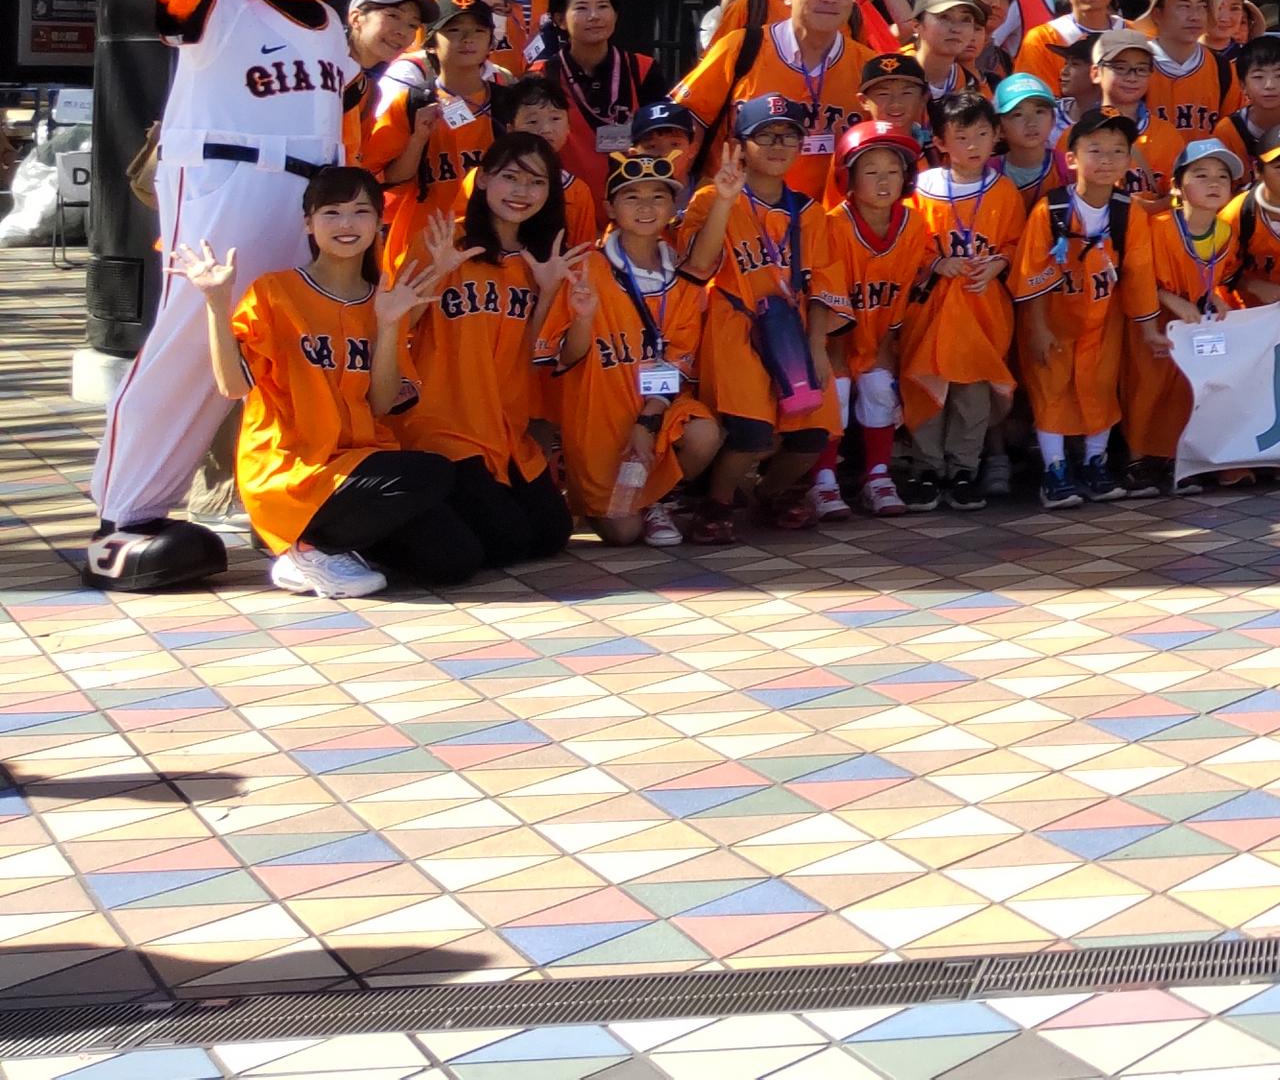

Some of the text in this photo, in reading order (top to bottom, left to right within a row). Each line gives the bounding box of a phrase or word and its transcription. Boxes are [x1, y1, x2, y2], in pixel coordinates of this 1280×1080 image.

[650, 104, 670, 119] L
[767, 96, 788, 115] B
[817, 143, 828, 153] A
[659, 381, 671, 392] A
